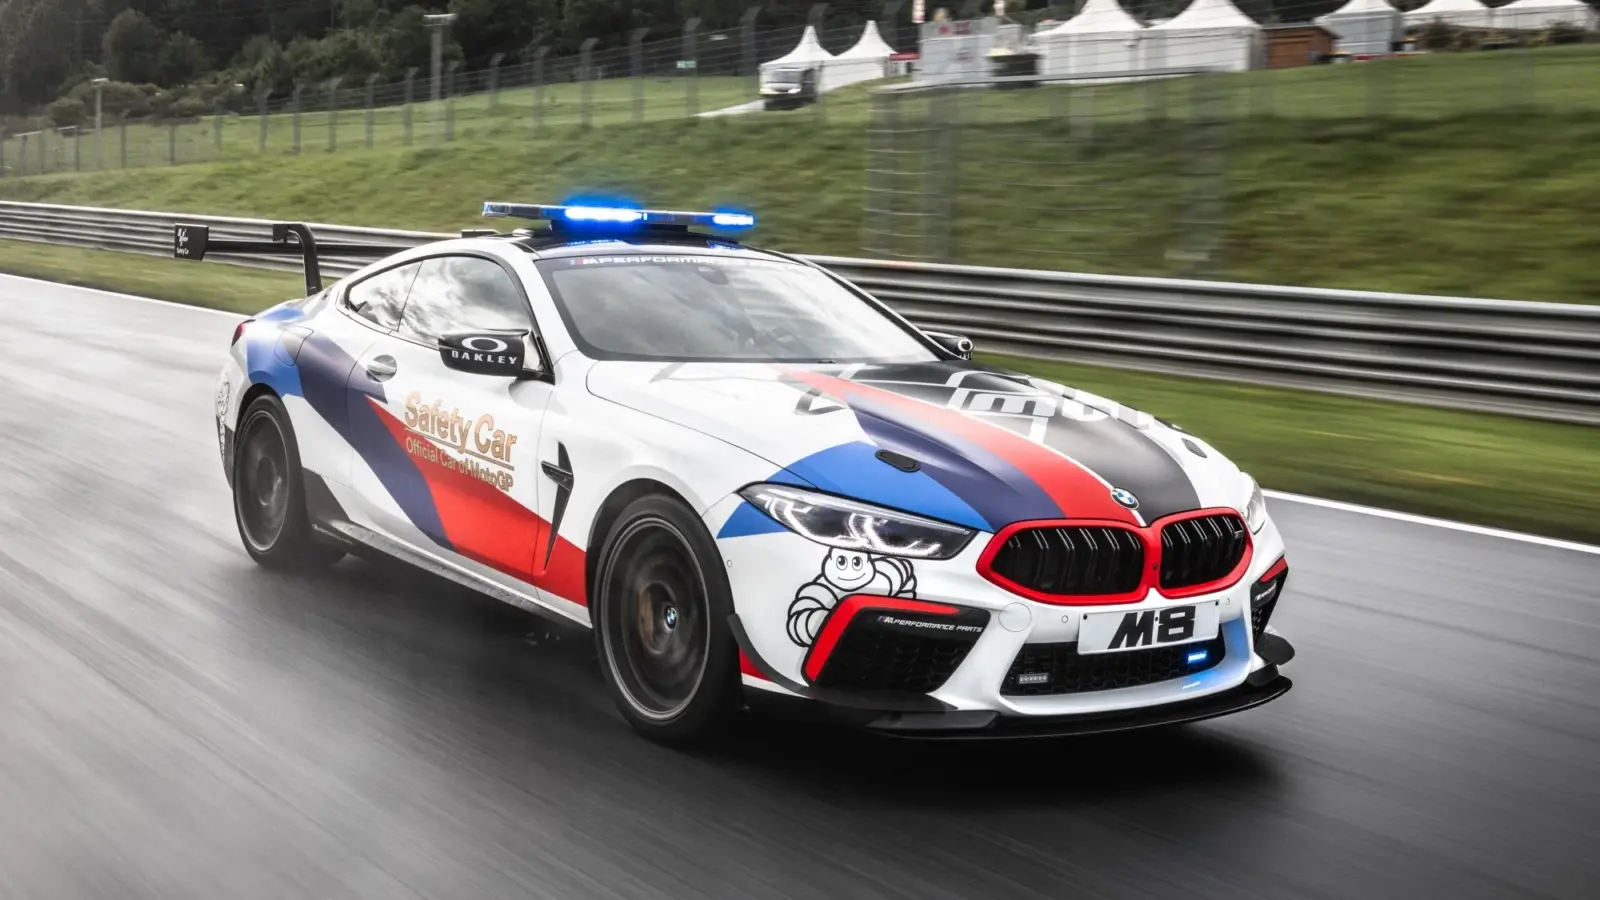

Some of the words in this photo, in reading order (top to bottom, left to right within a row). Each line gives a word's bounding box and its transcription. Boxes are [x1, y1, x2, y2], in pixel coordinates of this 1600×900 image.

[451, 350, 517, 365] OAKLEY
[404, 391, 472, 454] Safety
[474, 413, 518, 462] Car
[406, 436, 439, 464] Official
[440, 449, 457, 470] Car
[459, 457, 470, 476] of
[469, 459, 514, 493] MotoGP
[956, 625, 983, 633] PARTS
[1107, 605, 1196, 650] M8
